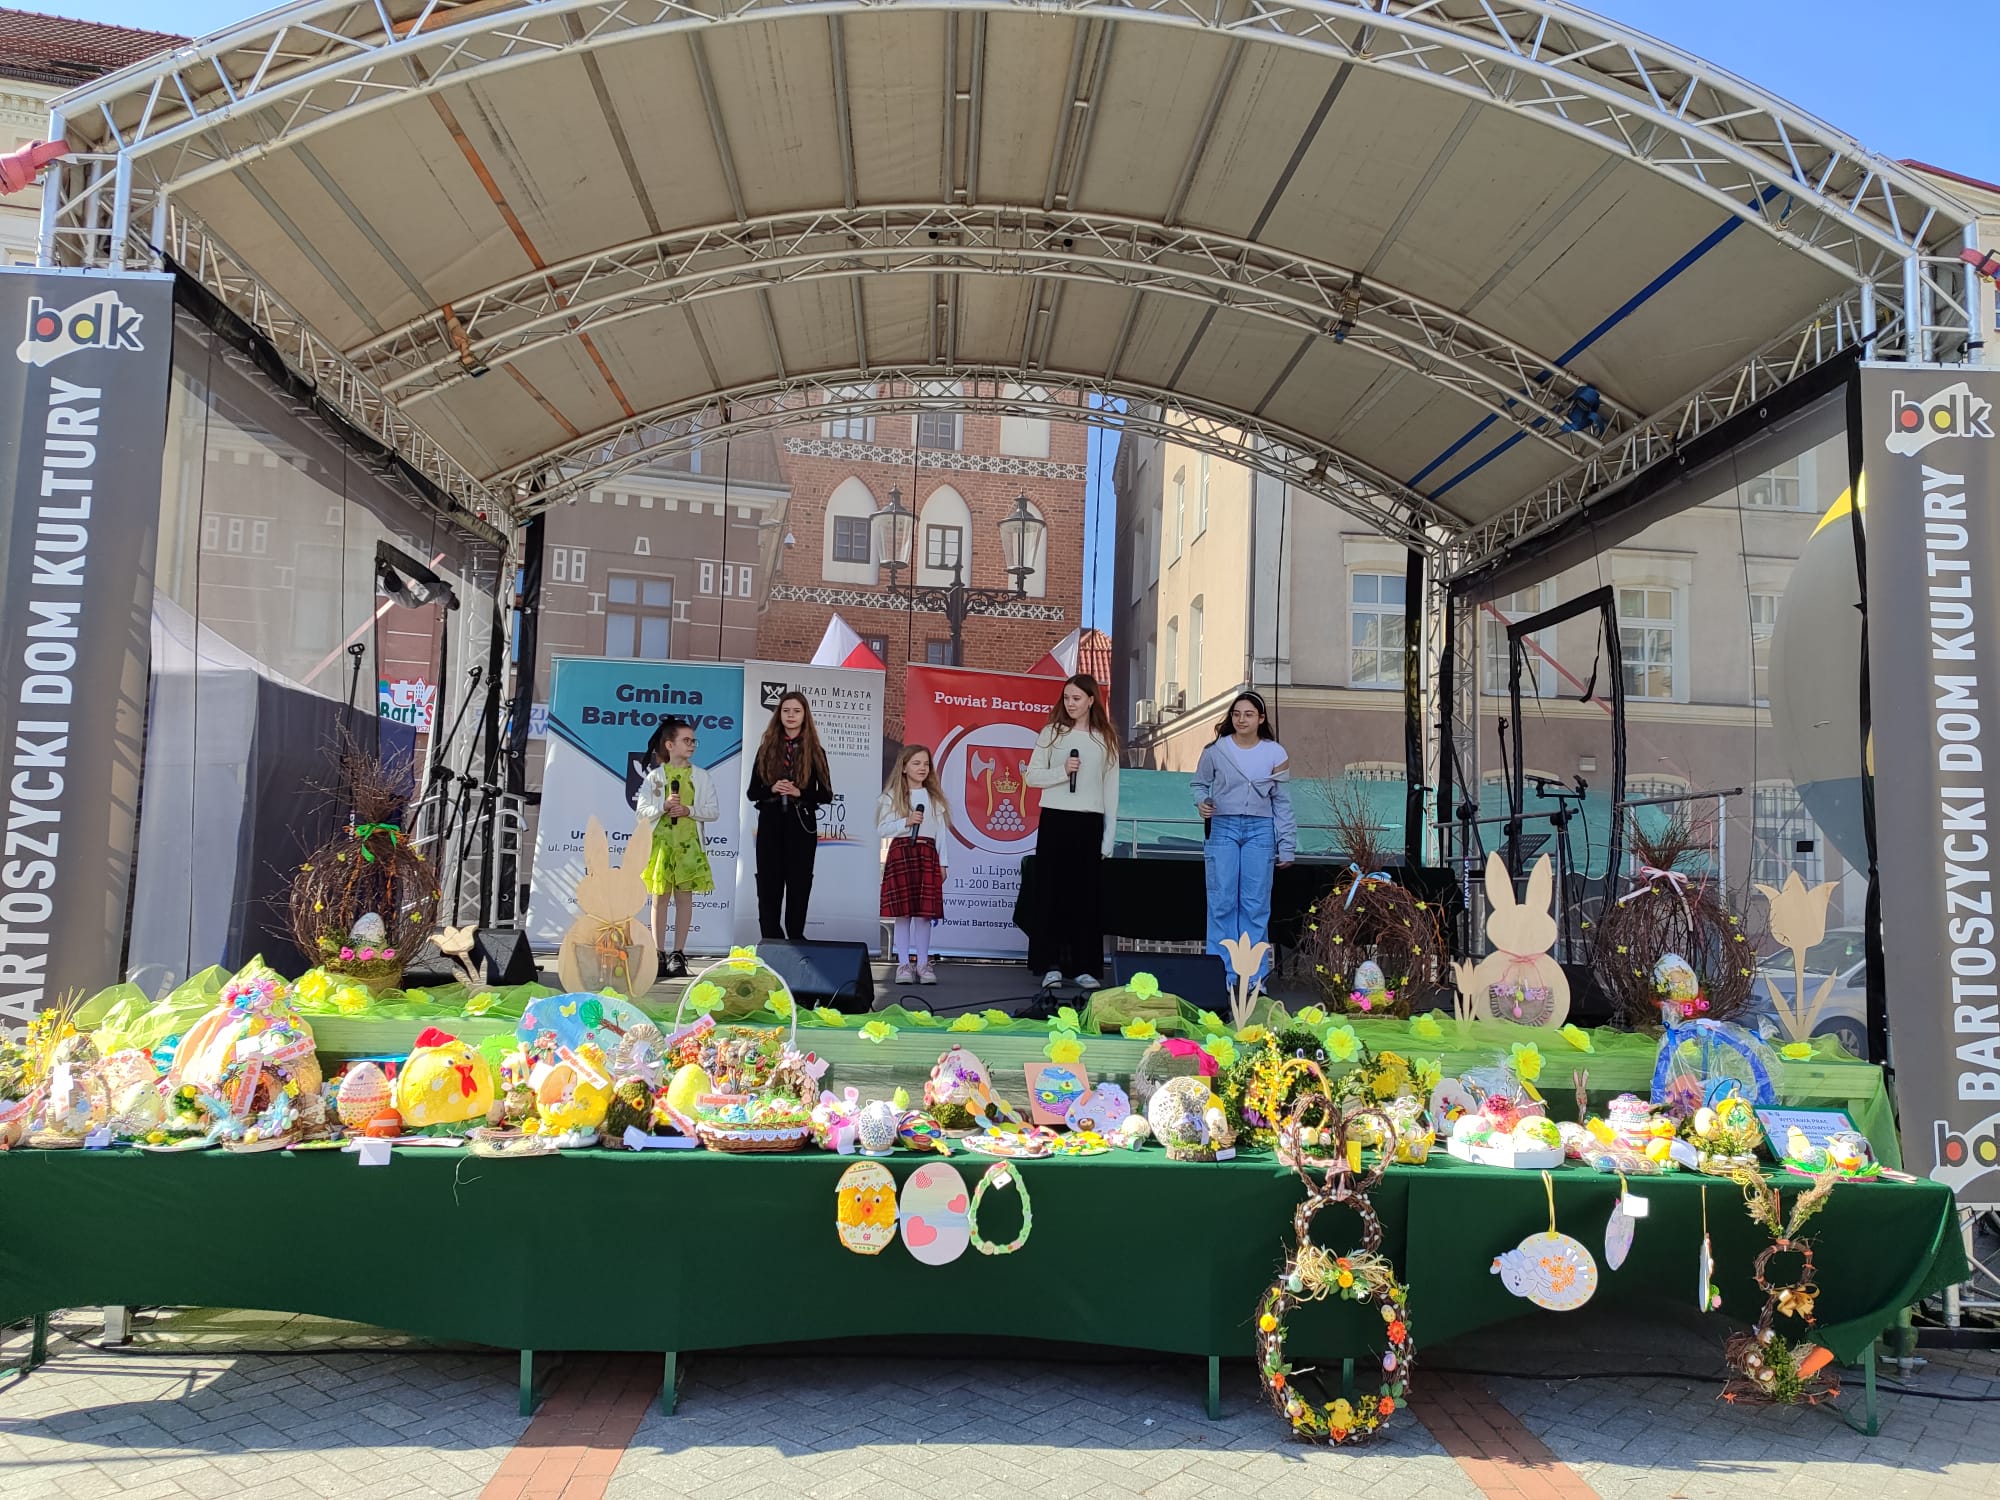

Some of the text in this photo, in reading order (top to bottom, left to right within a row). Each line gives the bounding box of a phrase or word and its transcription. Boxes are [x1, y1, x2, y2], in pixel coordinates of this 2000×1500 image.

[28, 299, 140, 348] bdk
[1894, 393, 1992, 436] bdk
[31, 376, 102, 586] KULTURY
[19, 601, 82, 705] DOM
[616, 684, 703, 704] Gmina
[832, 687, 872, 699] MIASTA
[934, 691, 988, 709] Powiat
[380, 701, 434, 725] Bart-S
[1921, 464, 2000, 1101] BARTOSZYCKI DOM KULTURY
[972, 865, 1021, 877] ul. Lipow
[954, 878, 1021, 890] 11-200 Barto
[942, 918, 970, 927] Powiat
[1937, 1123, 2000, 1168] bd
